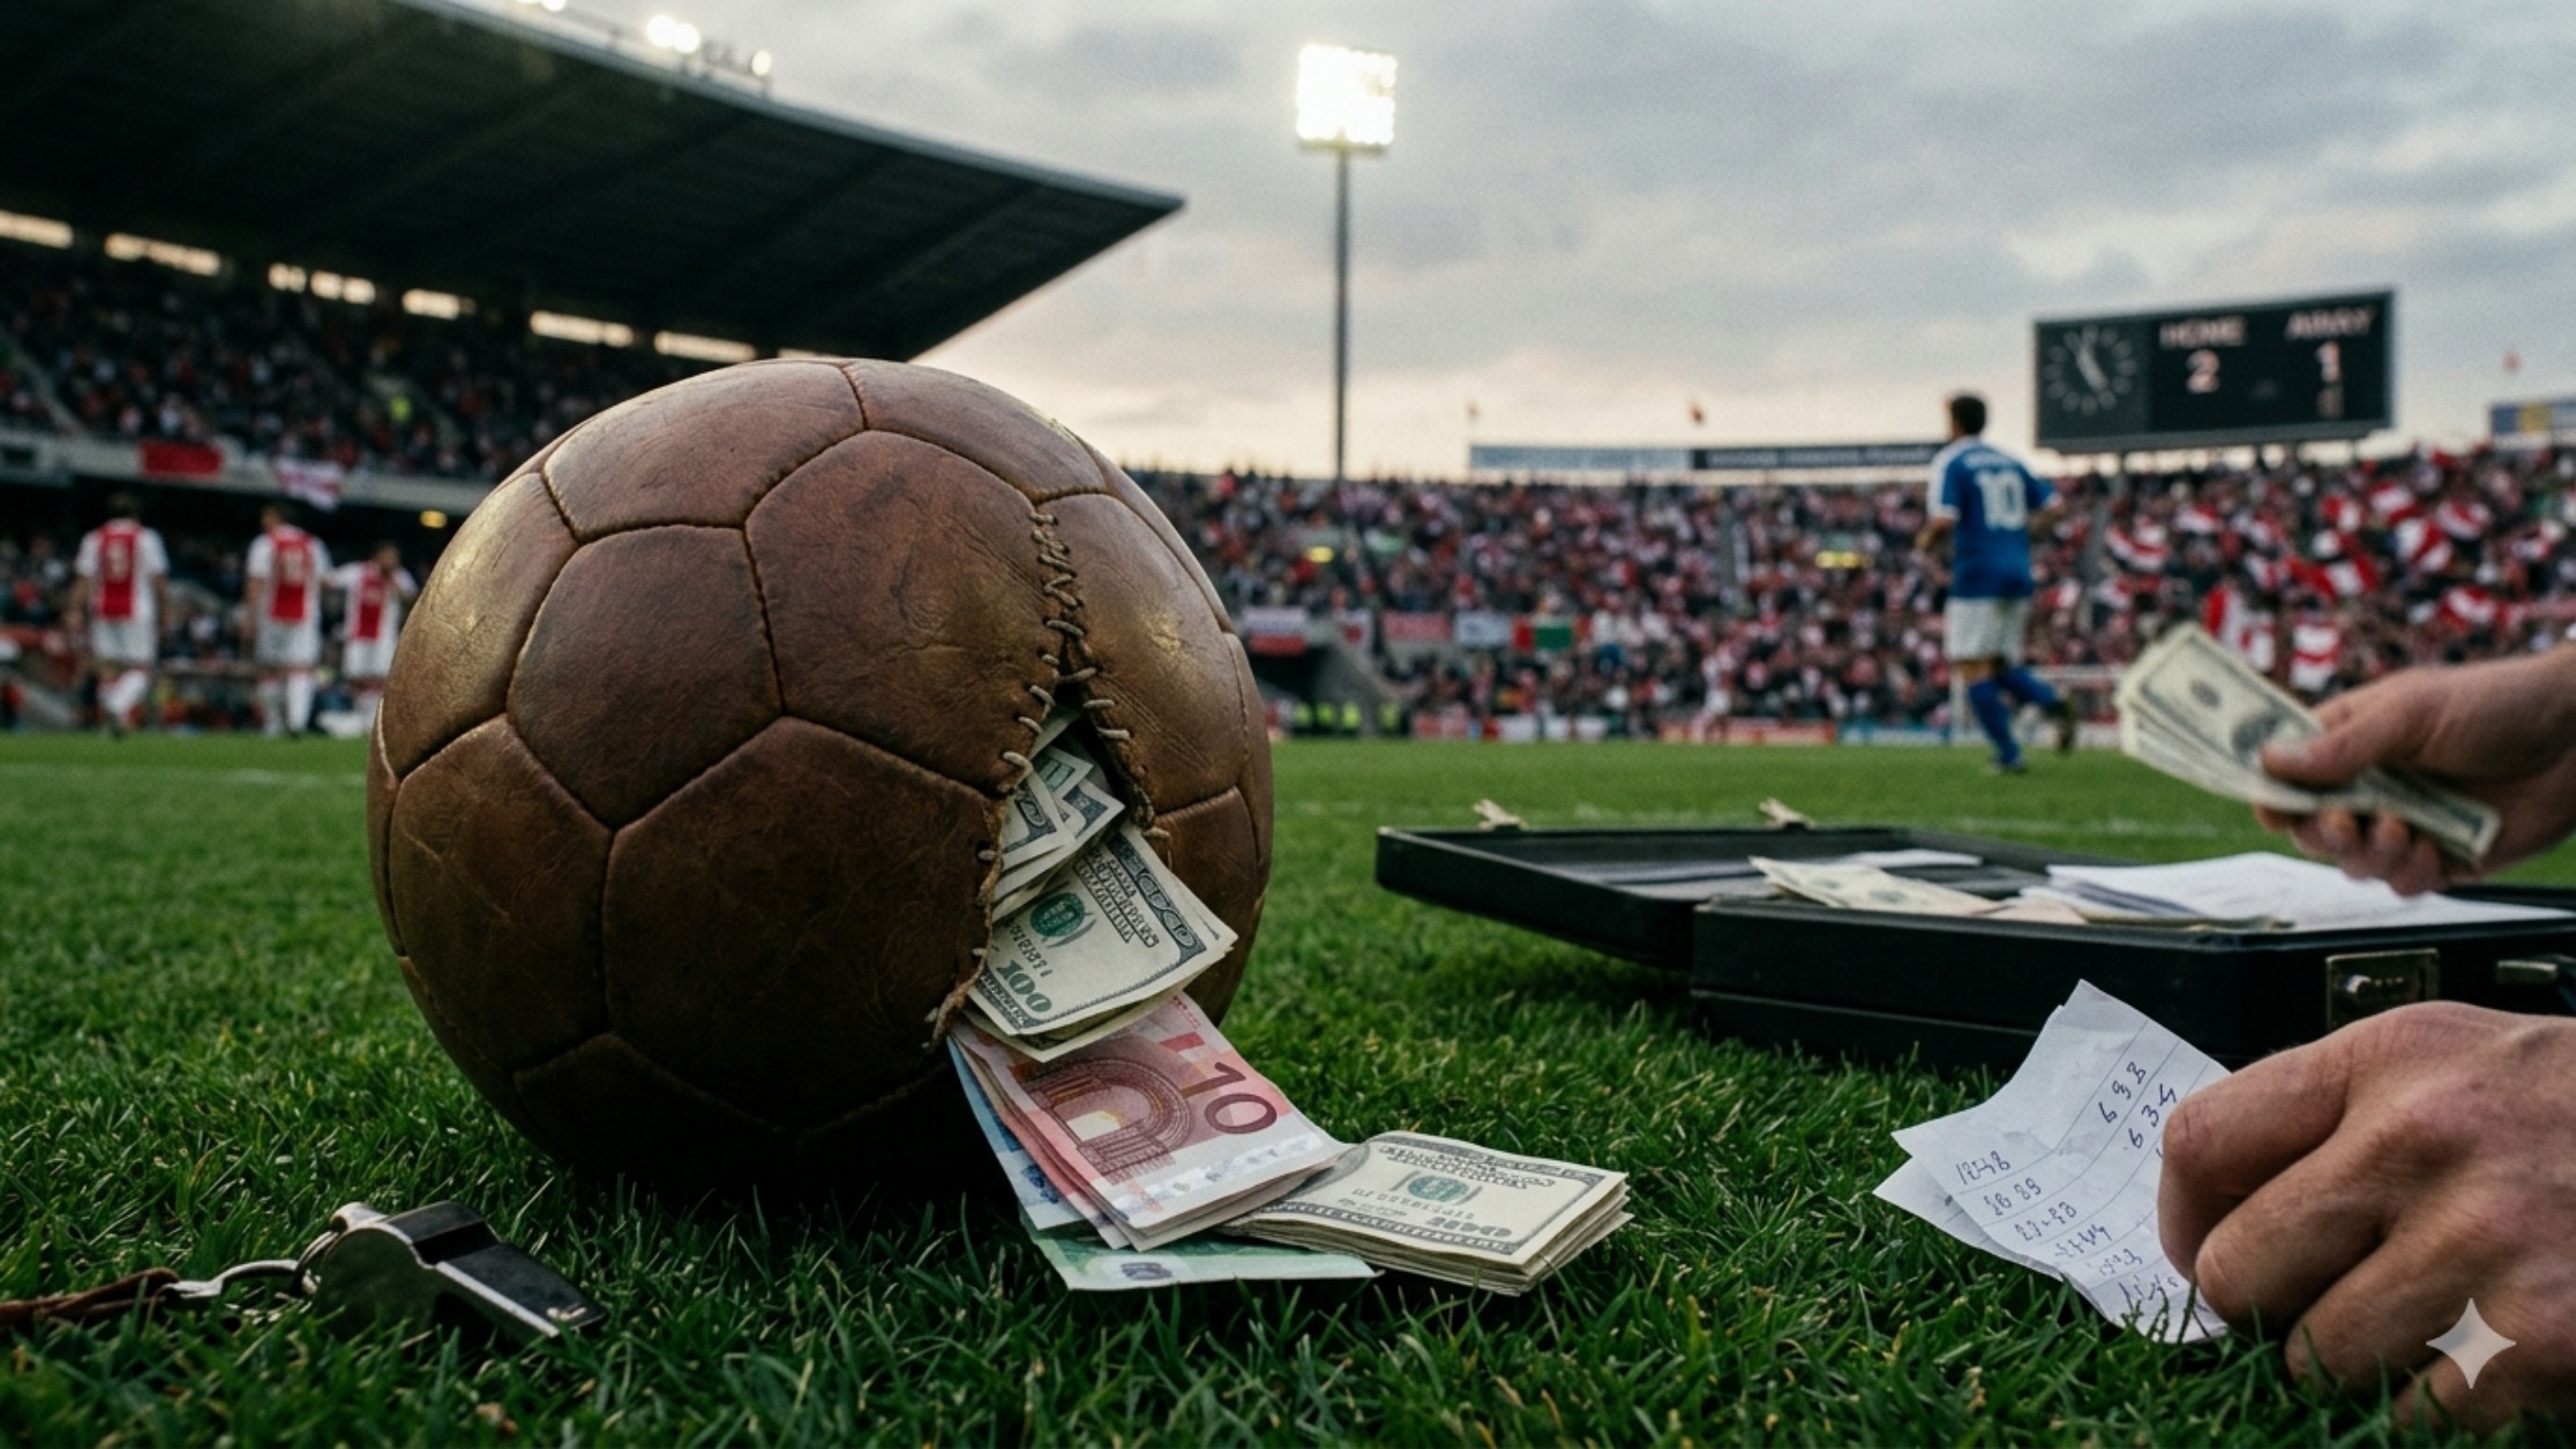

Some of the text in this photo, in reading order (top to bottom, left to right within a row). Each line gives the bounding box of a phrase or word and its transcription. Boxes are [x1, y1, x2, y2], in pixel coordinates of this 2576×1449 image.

[2186, 340, 2341, 394] 2 1
[1974, 469, 2026, 531] 10
[996, 960, 1053, 1013] 100
[1179, 1062, 1277, 1134] 10
